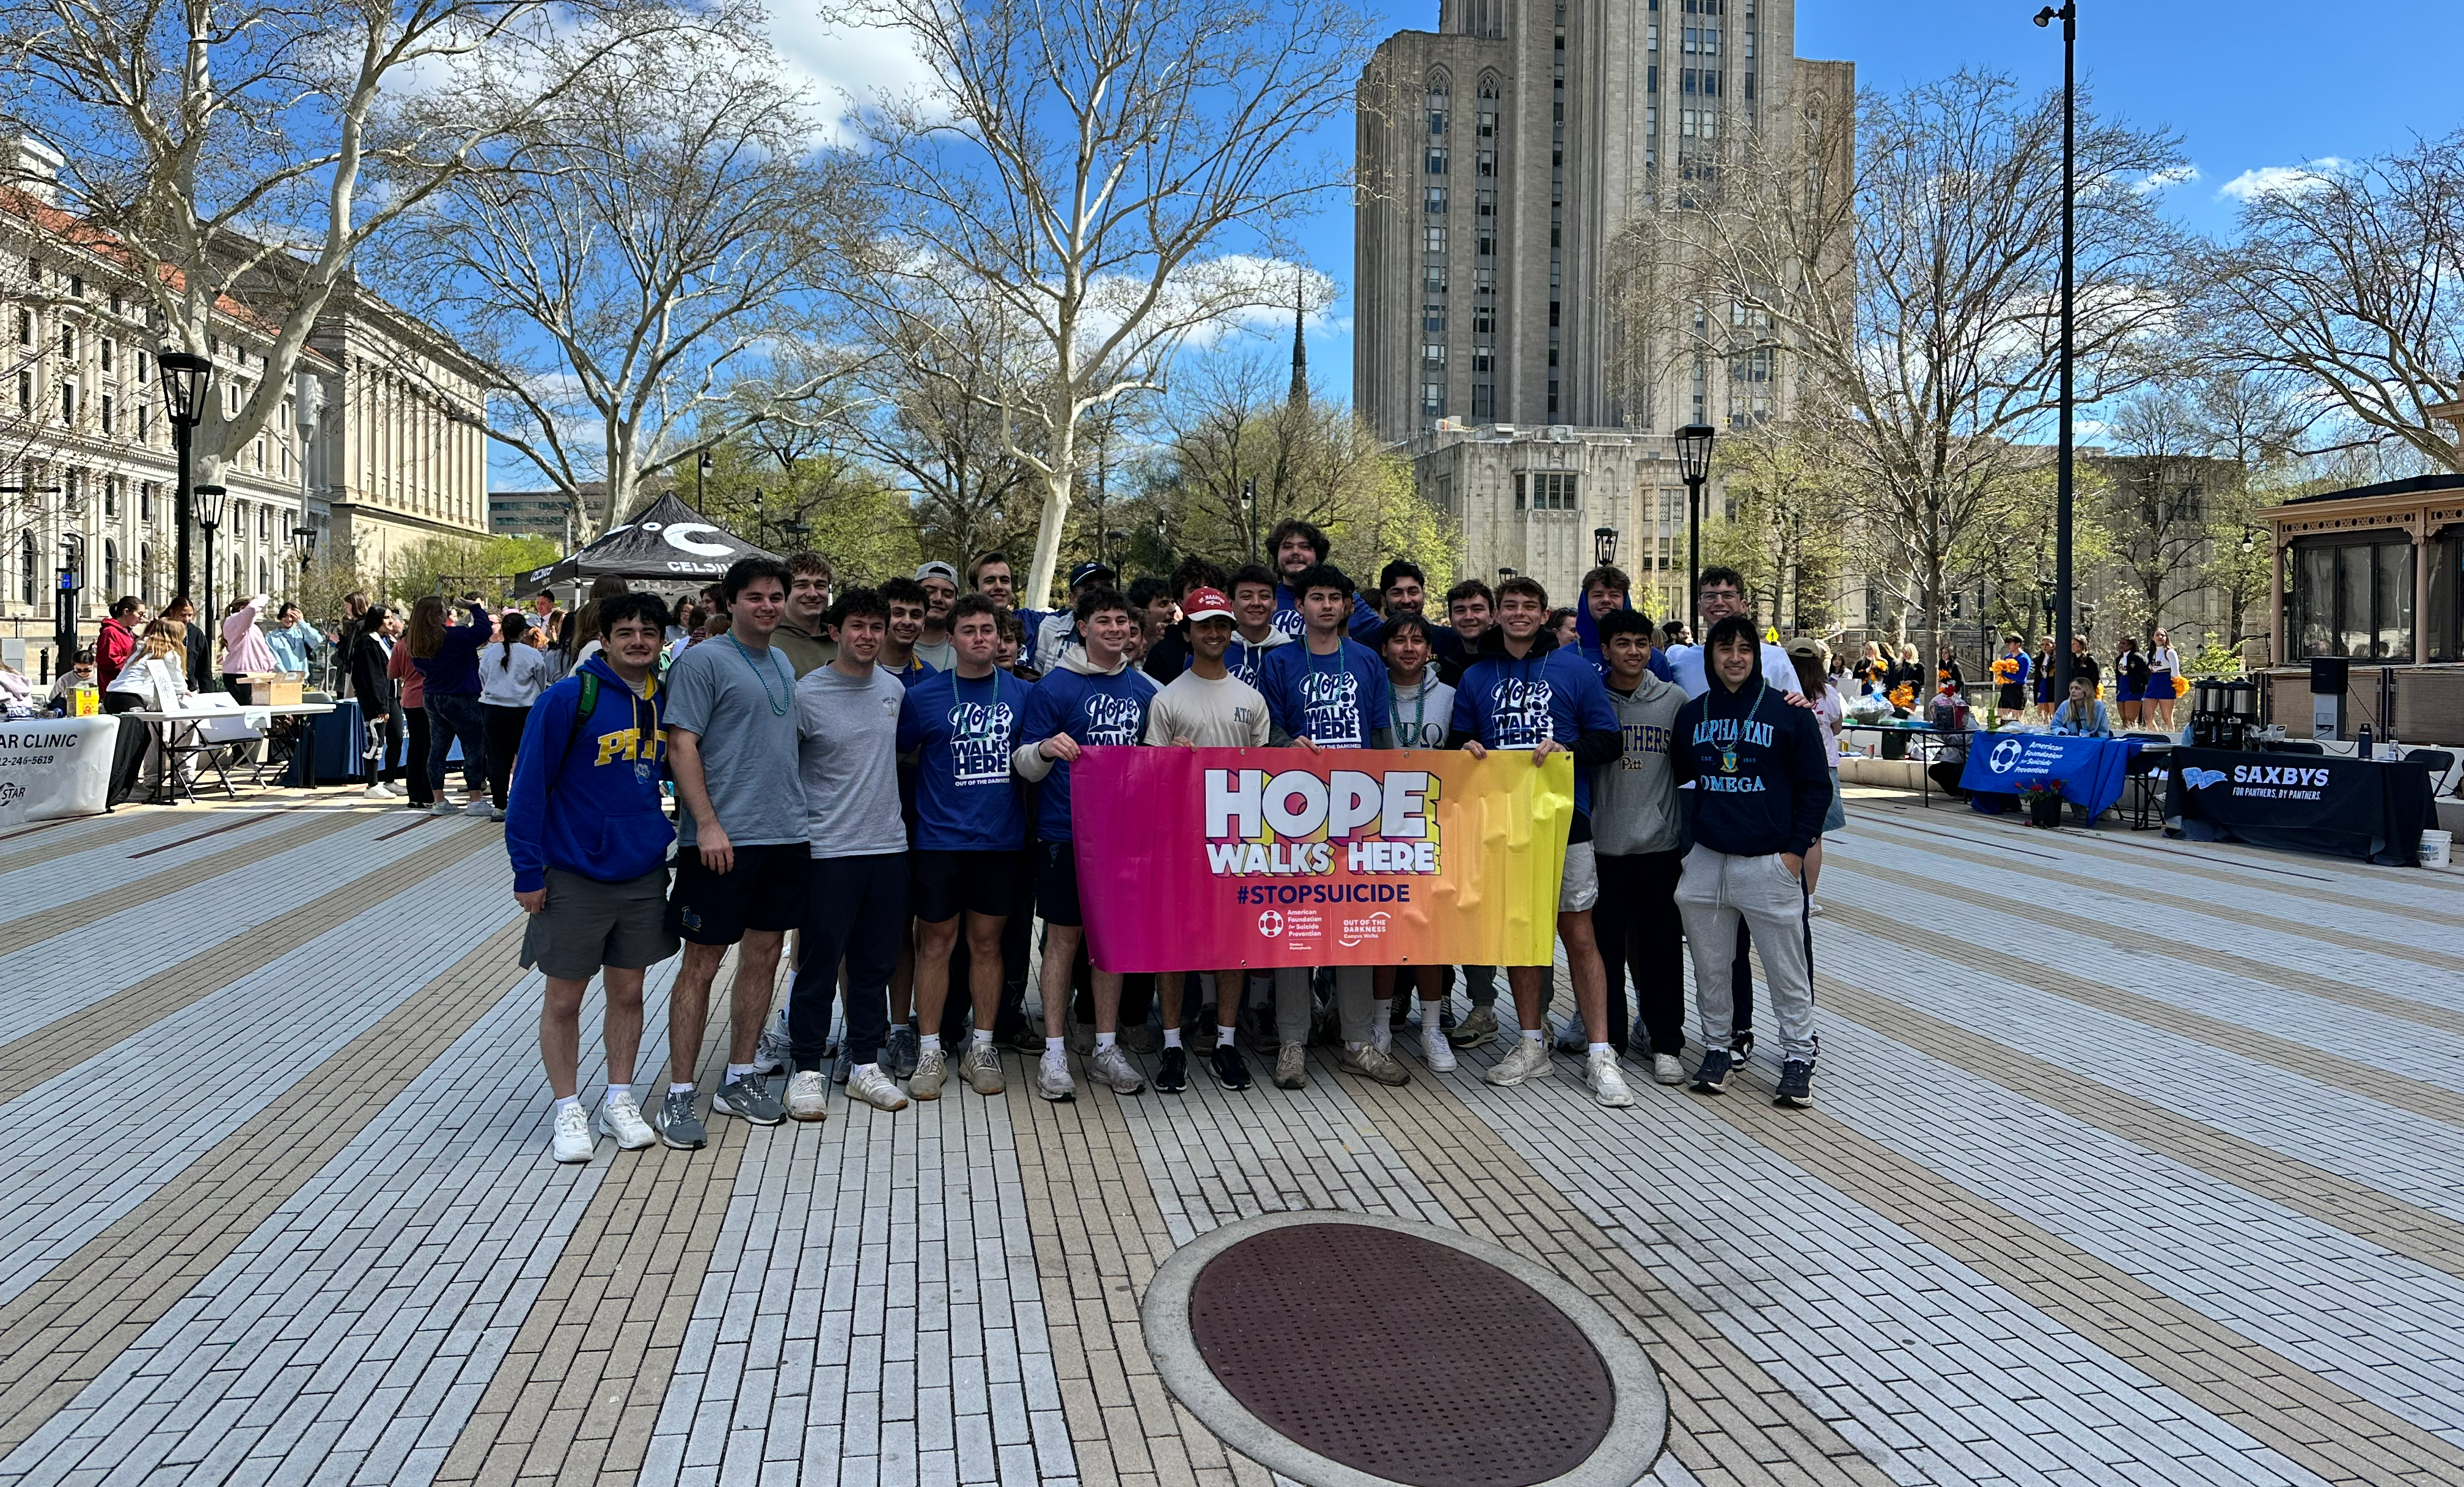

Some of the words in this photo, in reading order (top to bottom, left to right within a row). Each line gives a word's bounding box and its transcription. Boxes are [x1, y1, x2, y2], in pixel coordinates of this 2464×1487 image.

[1305, 707, 1359, 723] WALKS
[1492, 715, 1553, 730] WALKS
[1307, 720, 1361, 742] HERE
[1494, 727, 1553, 746] HERE
[1692, 719, 1739, 746] ALPHA
[1744, 719, 1774, 748] TAU
[23, 734, 78, 749] CLINIC
[951, 740, 1010, 757] WALKS
[2029, 741, 2064, 751] American
[2024, 750, 2063, 759] Foundation
[953, 754, 1010, 777] HERE
[1618, 756, 1643, 771] Pitt
[1700, 775, 1766, 793] OMEGA
[2234, 765, 2329, 787] SAXBYS
[1, 787, 26, 800] STAR
[2232, 787, 2244, 796] FOR
[2245, 787, 2277, 799] PANTHERS,
[2278, 789, 2288, 798] BY
[1204, 769, 1436, 841] HOPE
[1205, 840, 1333, 875] WALKS
[1348, 841, 1440, 875] HERE
[1238, 884, 1410, 905] #STOPSUICIDE
